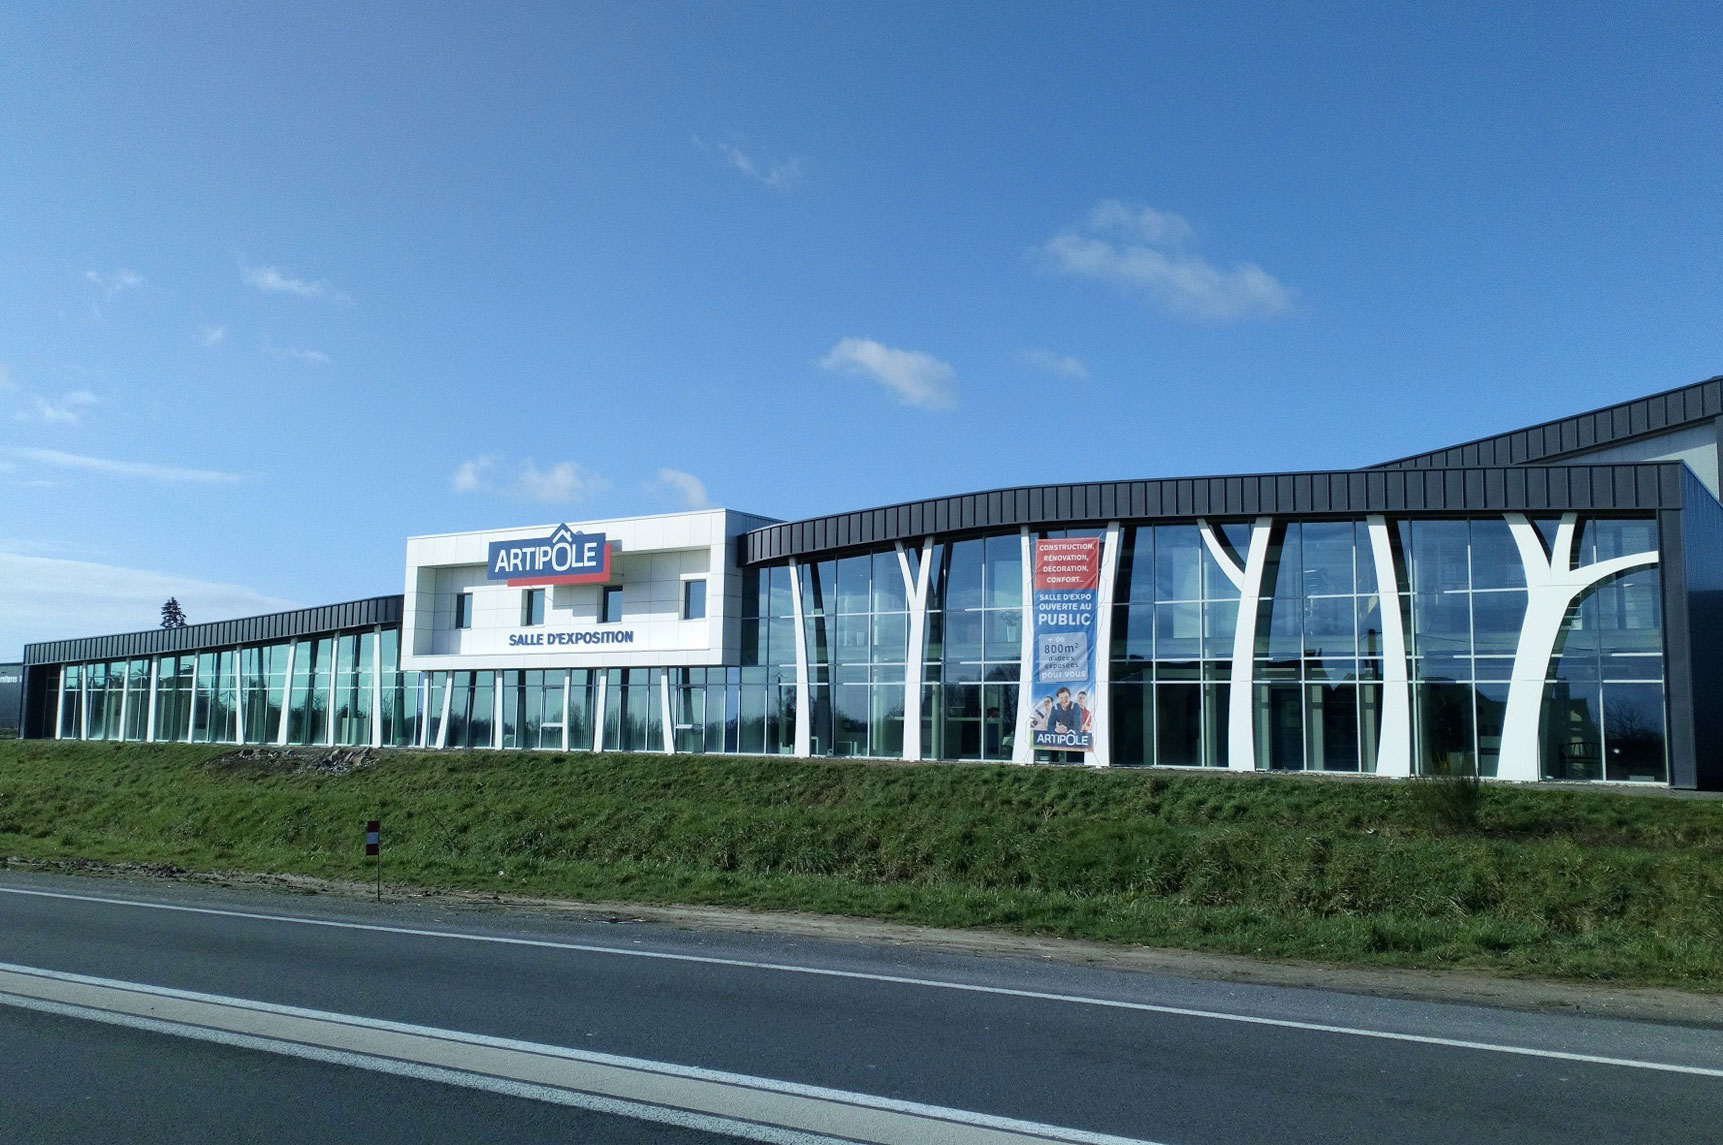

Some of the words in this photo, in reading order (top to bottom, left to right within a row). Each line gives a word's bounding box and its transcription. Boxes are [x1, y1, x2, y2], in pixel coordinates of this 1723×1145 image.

[494, 529, 597, 572] ARTIPÔLE
[1039, 543, 1095, 551] CONSTRUCTION,
[1043, 554, 1089, 562] RÉNOVATION,
[1038, 613, 1091, 625] PUBLIC
[509, 633, 544, 646] SALLE
[547, 631, 634, 645] D'EXPOSITION
[1041, 671, 1062, 680] pour
[1064, 670, 1086, 678] vous
[1036, 729, 1089, 746] ARTIPÔLE
